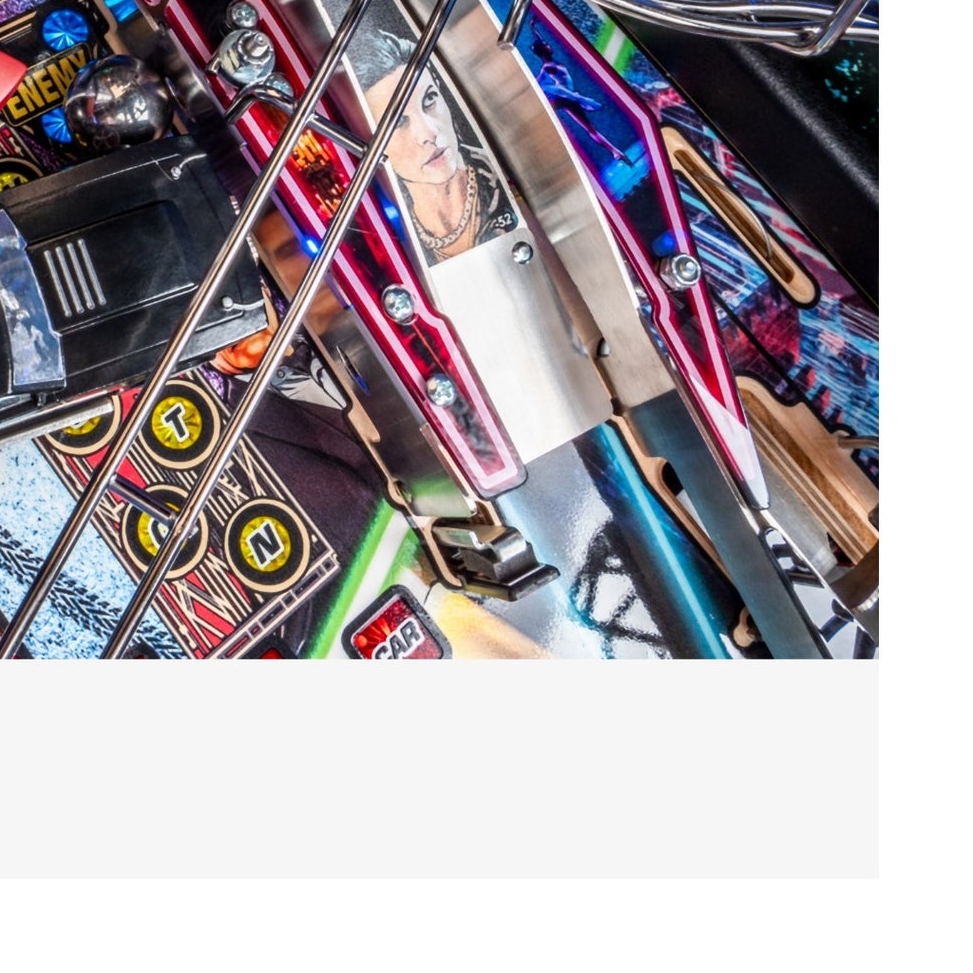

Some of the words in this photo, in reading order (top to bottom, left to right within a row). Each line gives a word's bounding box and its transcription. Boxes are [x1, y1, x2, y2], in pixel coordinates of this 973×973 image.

[6, 48, 87, 120] ENEMY
[162, 403, 189, 442] T
[247, 520, 285, 569] N
[373, 618, 424, 659] CAR
